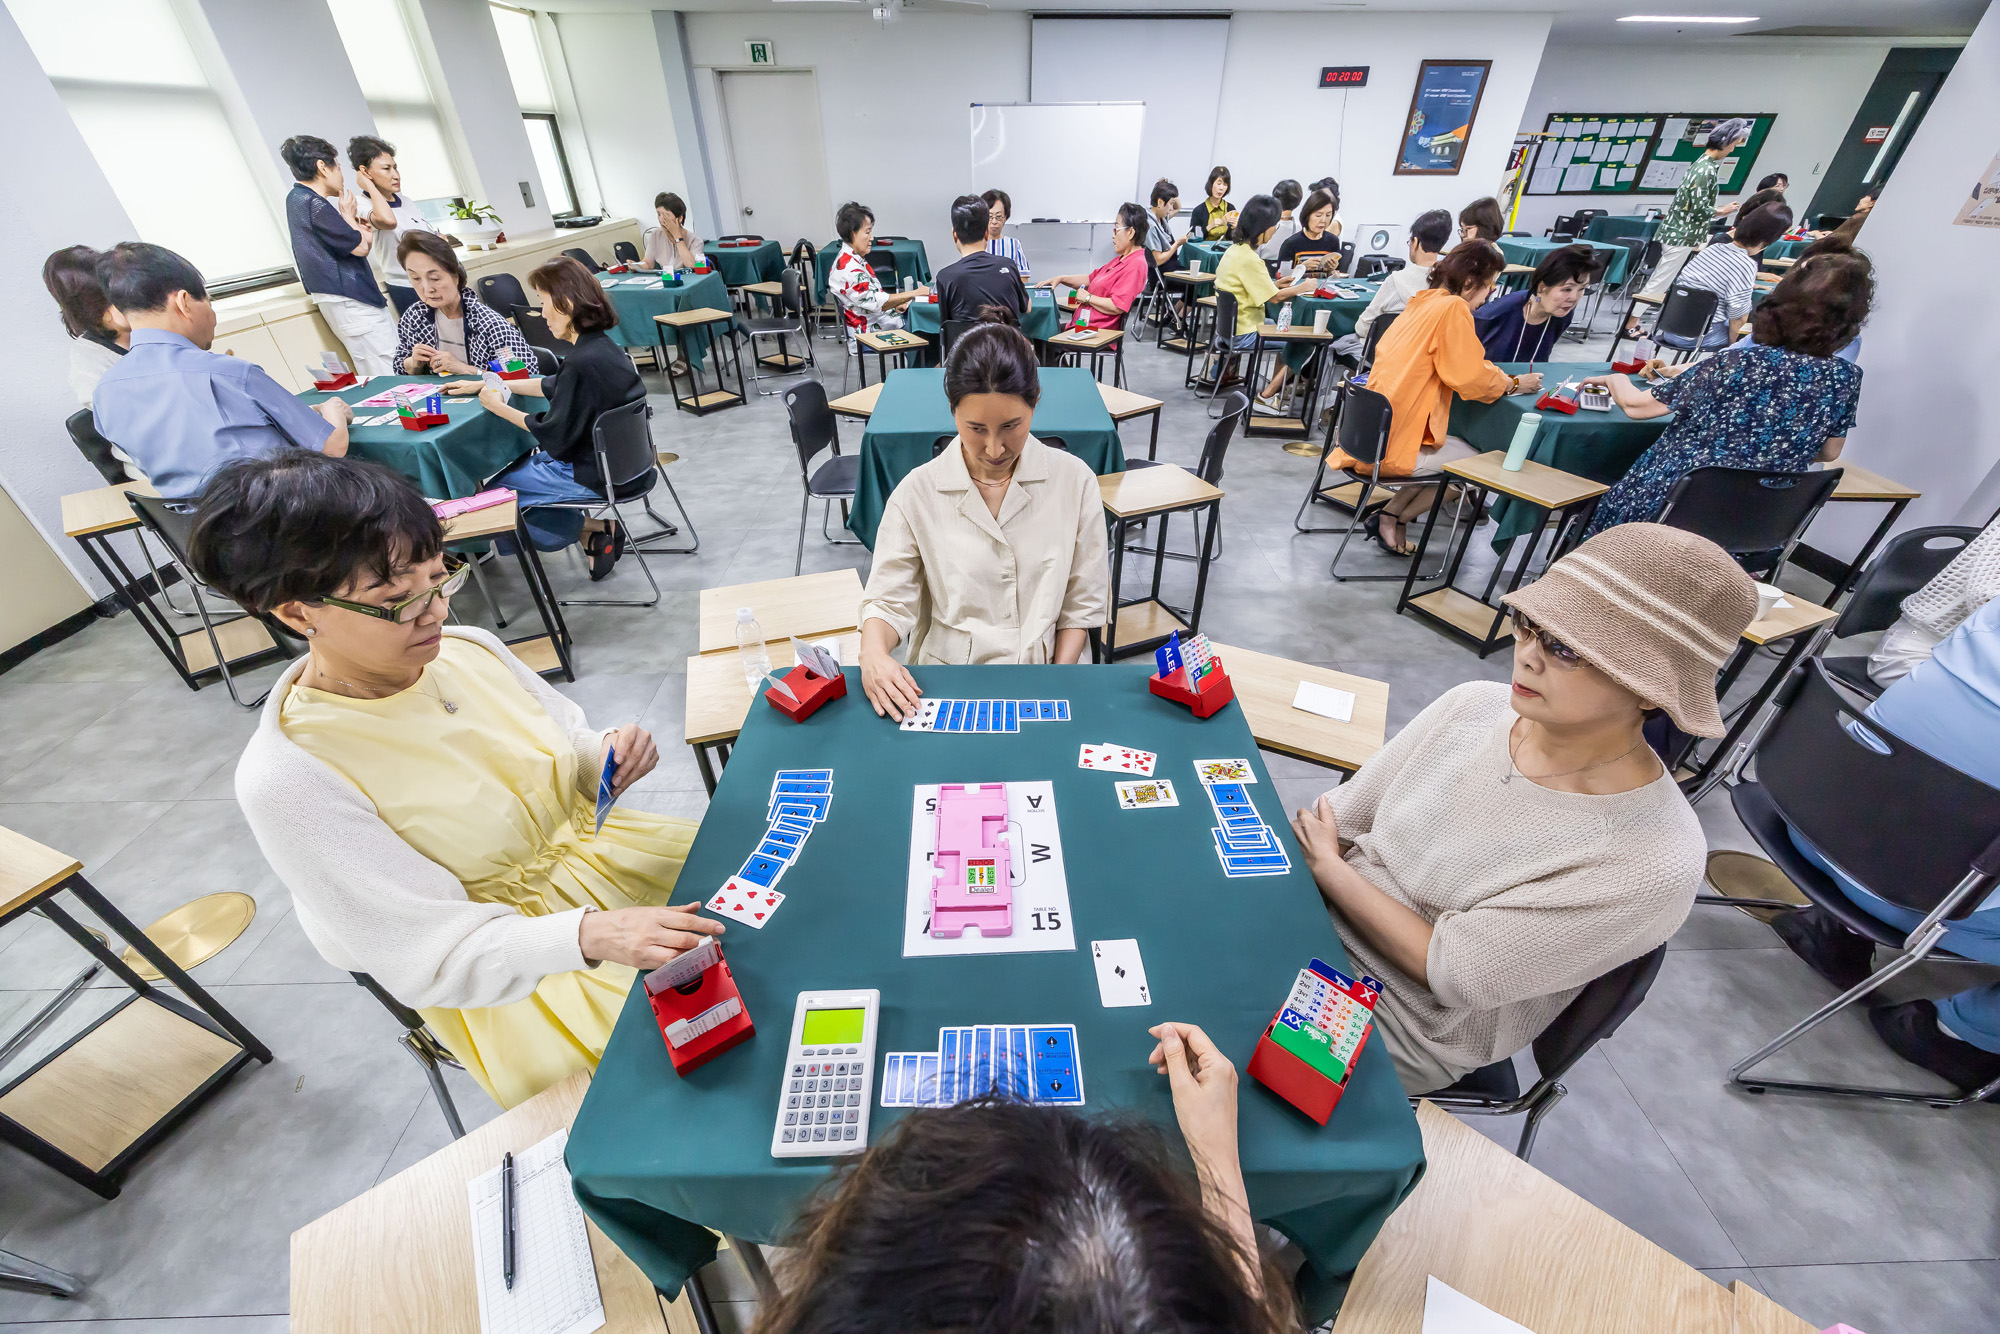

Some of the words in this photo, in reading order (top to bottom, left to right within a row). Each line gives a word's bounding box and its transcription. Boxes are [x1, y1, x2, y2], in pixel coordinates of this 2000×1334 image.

[1164, 648, 1176, 672] ALER
[926, 798, 936, 811] 5
[1026, 795, 1042, 808] A
[1032, 912, 1061, 930] 15
[1095, 943, 1101, 951] A
[1367, 980, 1376, 989] A
[1360, 987, 1375, 1002] X
[1284, 1011, 1303, 1028] XX
[1304, 1024, 1328, 1043] PASS
